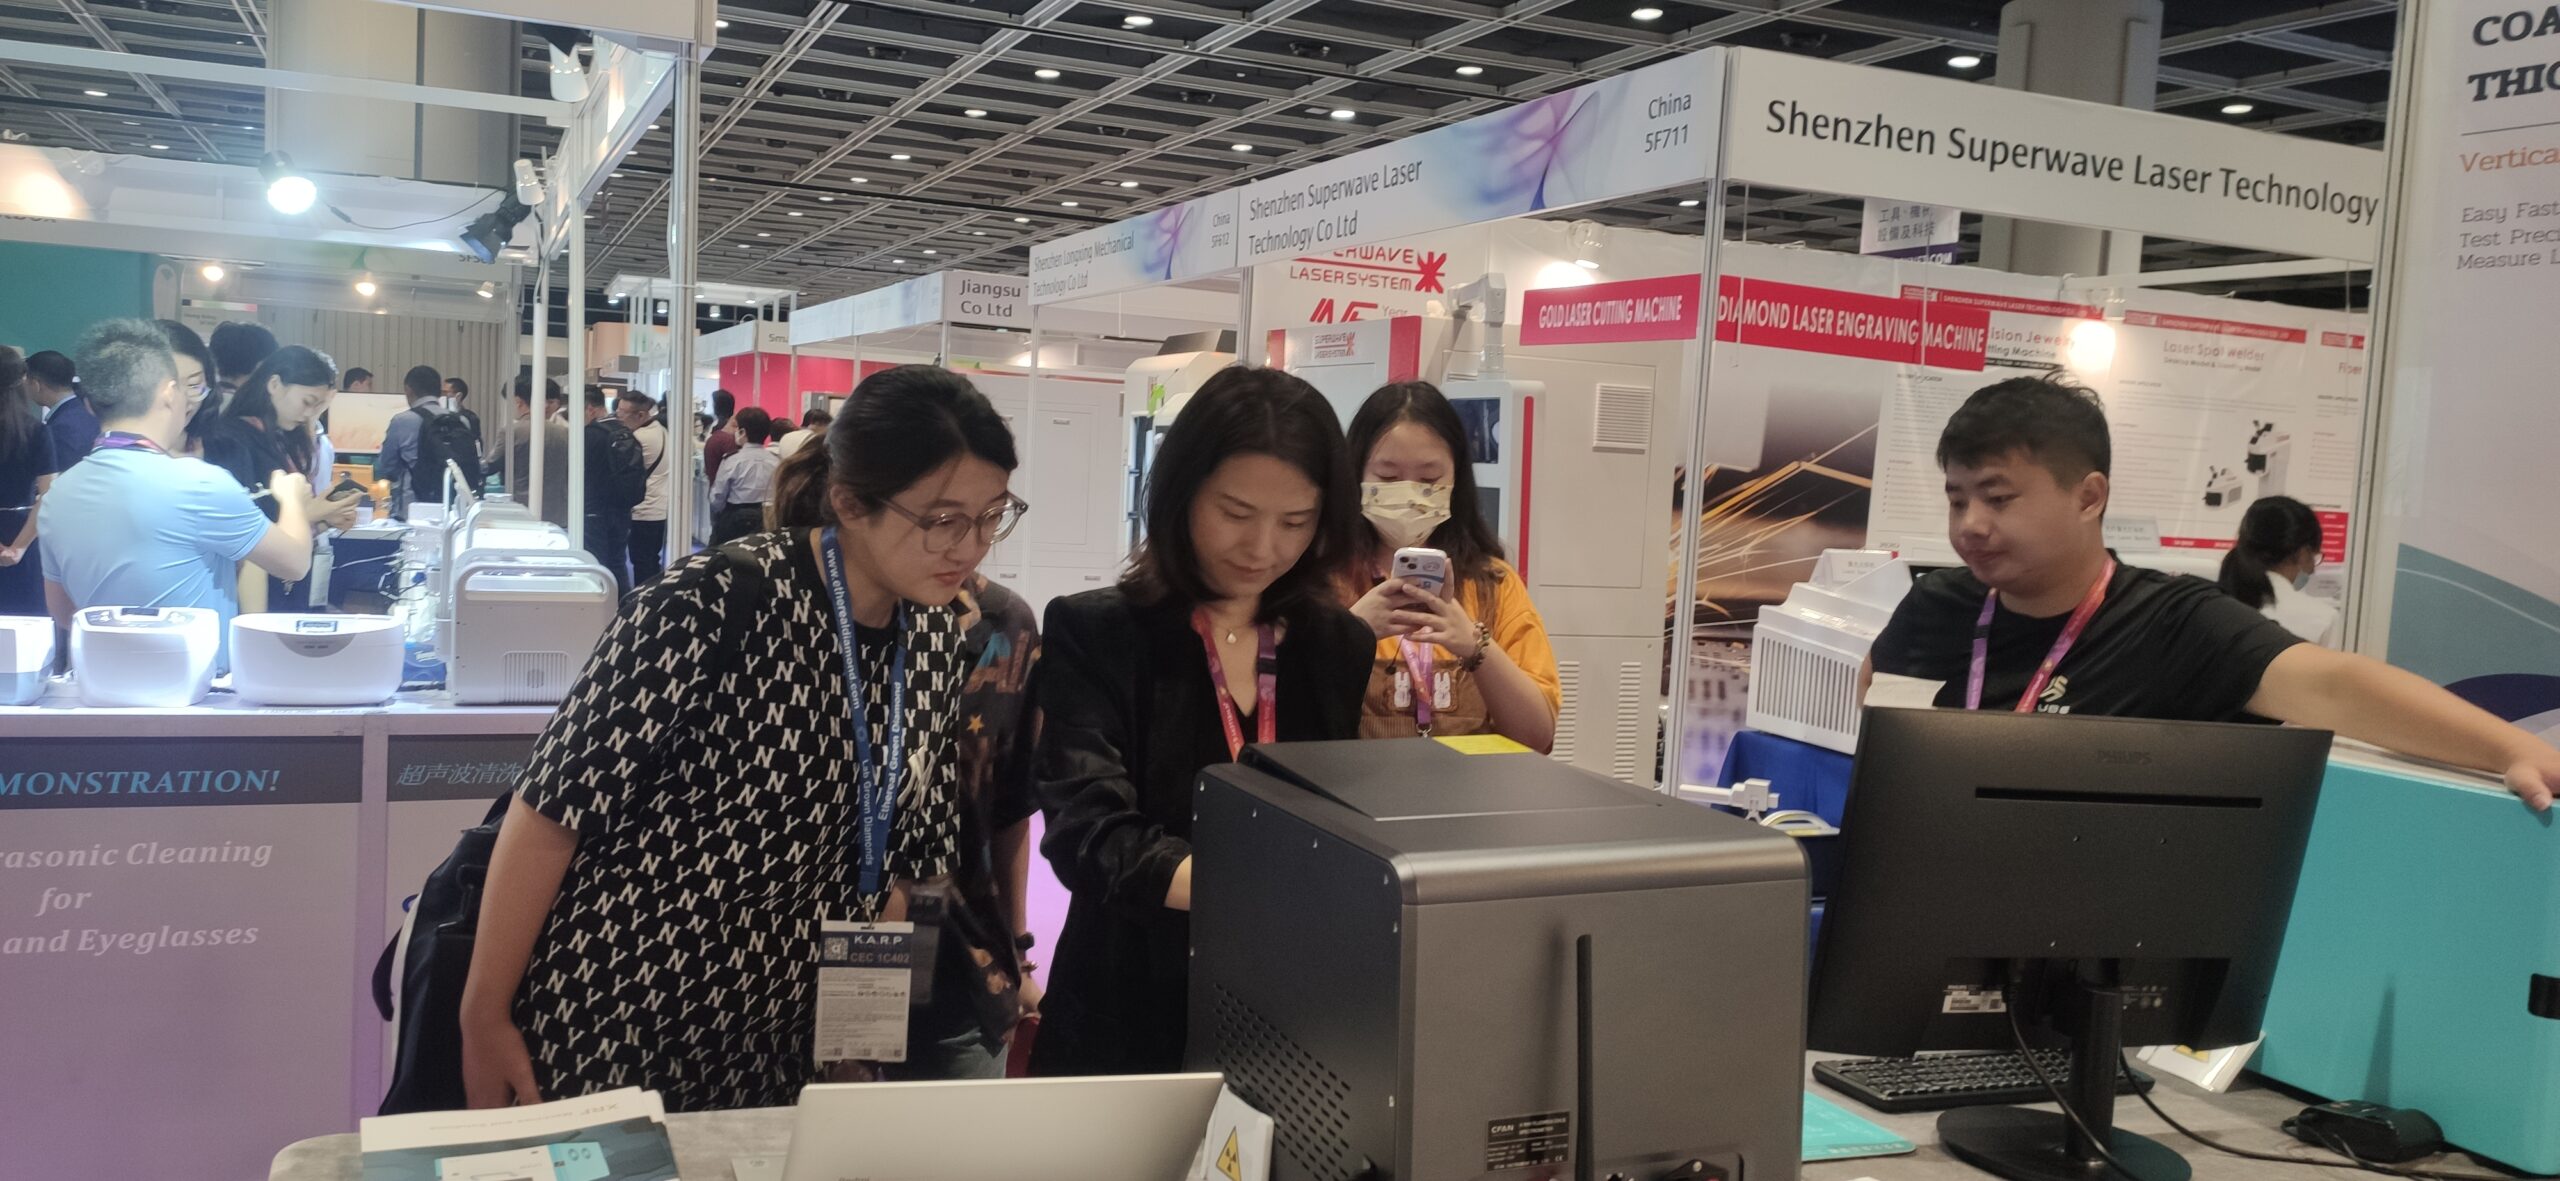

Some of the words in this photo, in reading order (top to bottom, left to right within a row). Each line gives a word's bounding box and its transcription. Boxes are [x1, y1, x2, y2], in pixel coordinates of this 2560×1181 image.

[1649, 93, 1692, 119] China
[1645, 124, 1689, 153] 5F711
[1766, 100, 1935, 155] Shenzhen
[1948, 127, 2123, 181] Superwave
[2133, 154, 2212, 194] Laser
[2219, 168, 2379, 226] Technology
[1250, 189, 1305, 221] Shenzhen
[1308, 171, 1379, 209] Superwave
[1383, 160, 1423, 189] Laser
[1213, 213, 1230, 228] China
[2461, 206, 2507, 224] Easy
[1249, 225, 1314, 256] Technology
[1316, 219, 1333, 242] Co
[1336, 209, 1358, 238] Ltd
[2459, 232, 2502, 249] Test
[1034, 254, 1063, 272] Shenzhen
[1093, 231, 1135, 258] Mechanical
[2456, 251, 2541, 270] Measure
[959, 279, 1021, 298] Jiangsu
[1033, 277, 1067, 297] Technology
[1068, 274, 1077, 290] Co
[1077, 270, 1088, 289] Ltd
[961, 301, 982, 315] Co
[987, 303, 1013, 317] Ltd
[1538, 304, 1566, 329] GOLD
[1565, 302, 1593, 327] LASER
[1593, 299, 1633, 326] CUTTING
[1634, 295, 1683, 323] MACHINE
[1718, 296, 1790, 329] DIAMOND
[1792, 304, 1834, 334] LASER
[1836, 310, 1919, 344] ENGRAVING
[1922, 319, 1985, 353] MACHINE
[0, 770, 281, 797] MONSTRATION!
[878, 772, 897, 821] Ethereal
[889, 735, 899, 771] Green
[863, 780, 871, 815] Grown
[126, 841, 273, 868] Cleaning
[863, 815, 873, 866] Diamonds
[35, 887, 93, 917] for
[4, 929, 71, 954] and
[77, 925, 259, 956] Eyeglasses
[850, 952, 874, 963] CEC
[878, 953, 910, 963] 1C402
